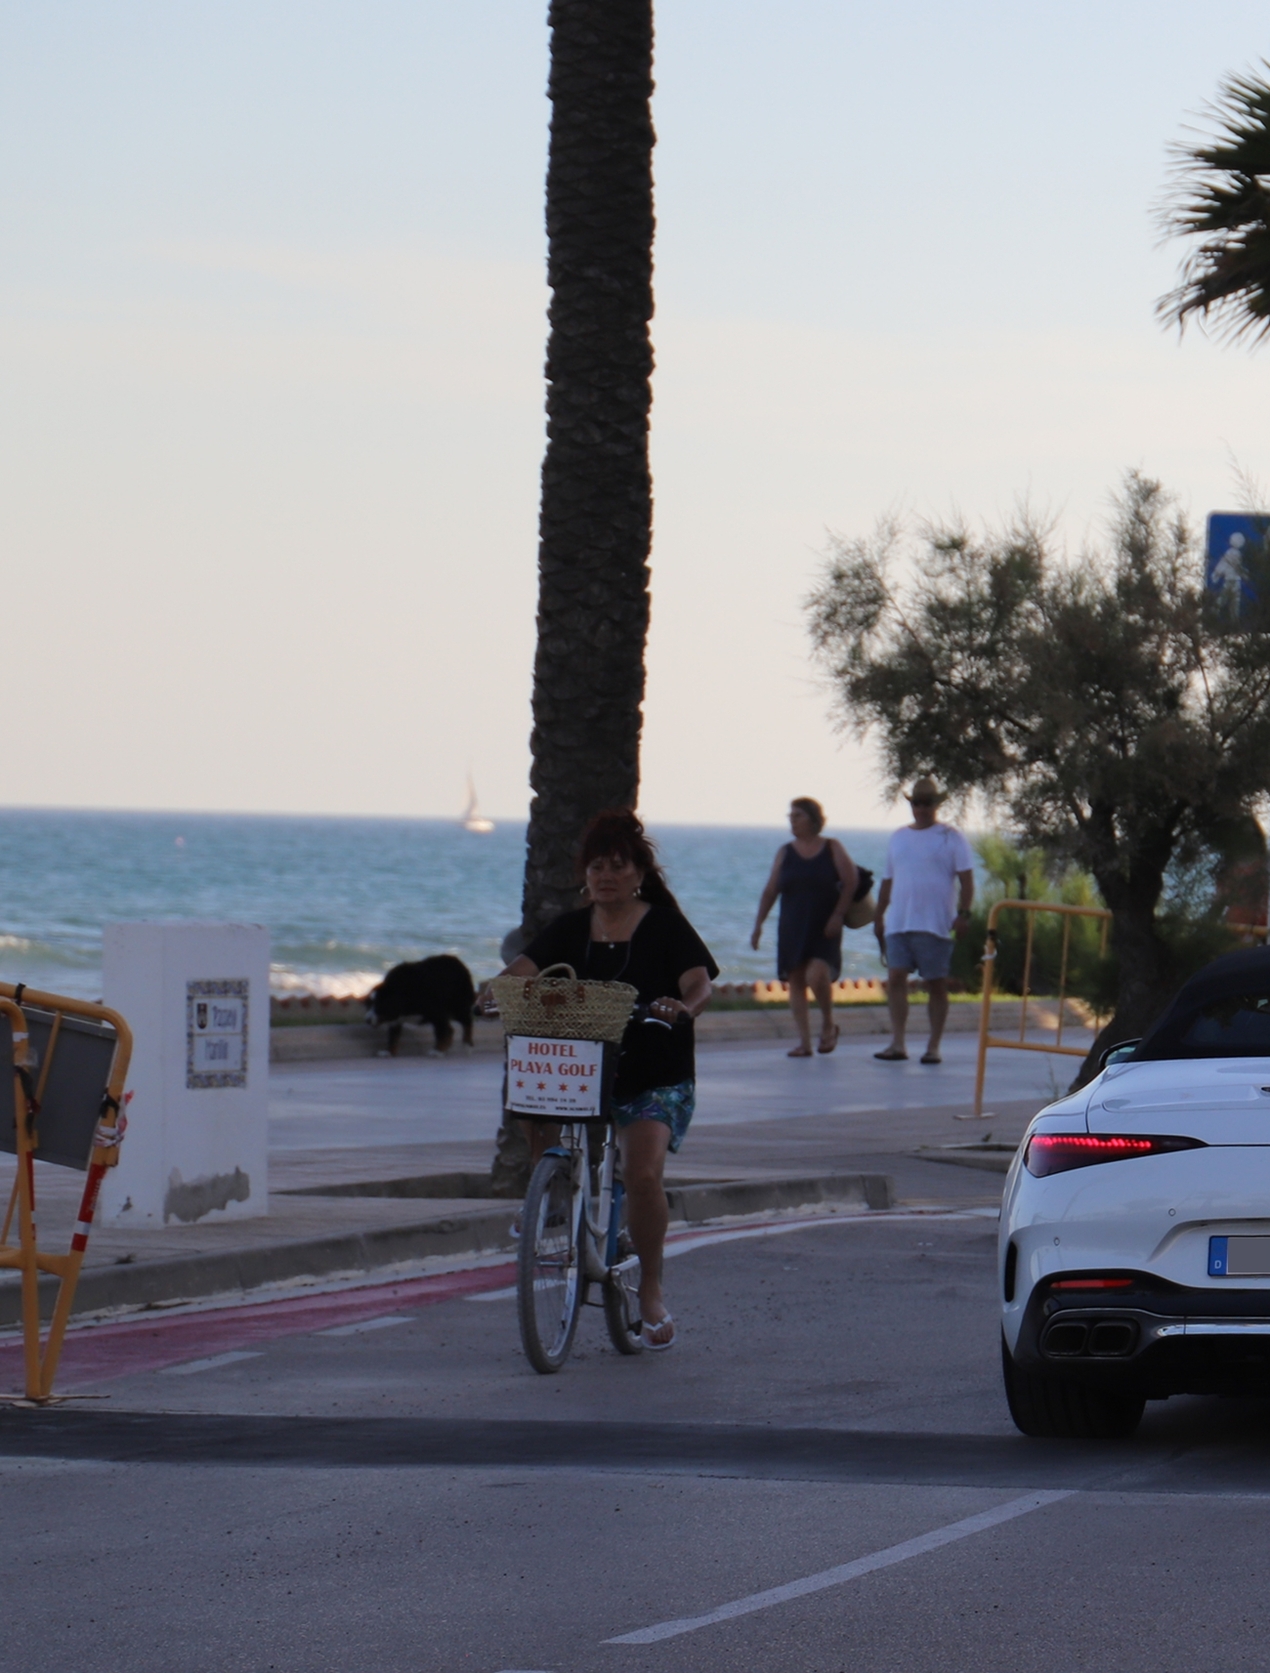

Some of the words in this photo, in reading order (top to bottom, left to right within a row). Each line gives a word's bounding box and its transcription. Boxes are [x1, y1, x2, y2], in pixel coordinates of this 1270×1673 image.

[528, 1042, 577, 1057] HOTEL
[511, 1059, 553, 1075] PLAYA
[558, 1063, 597, 1077] GOLF
[1214, 1260, 1222, 1269] D
